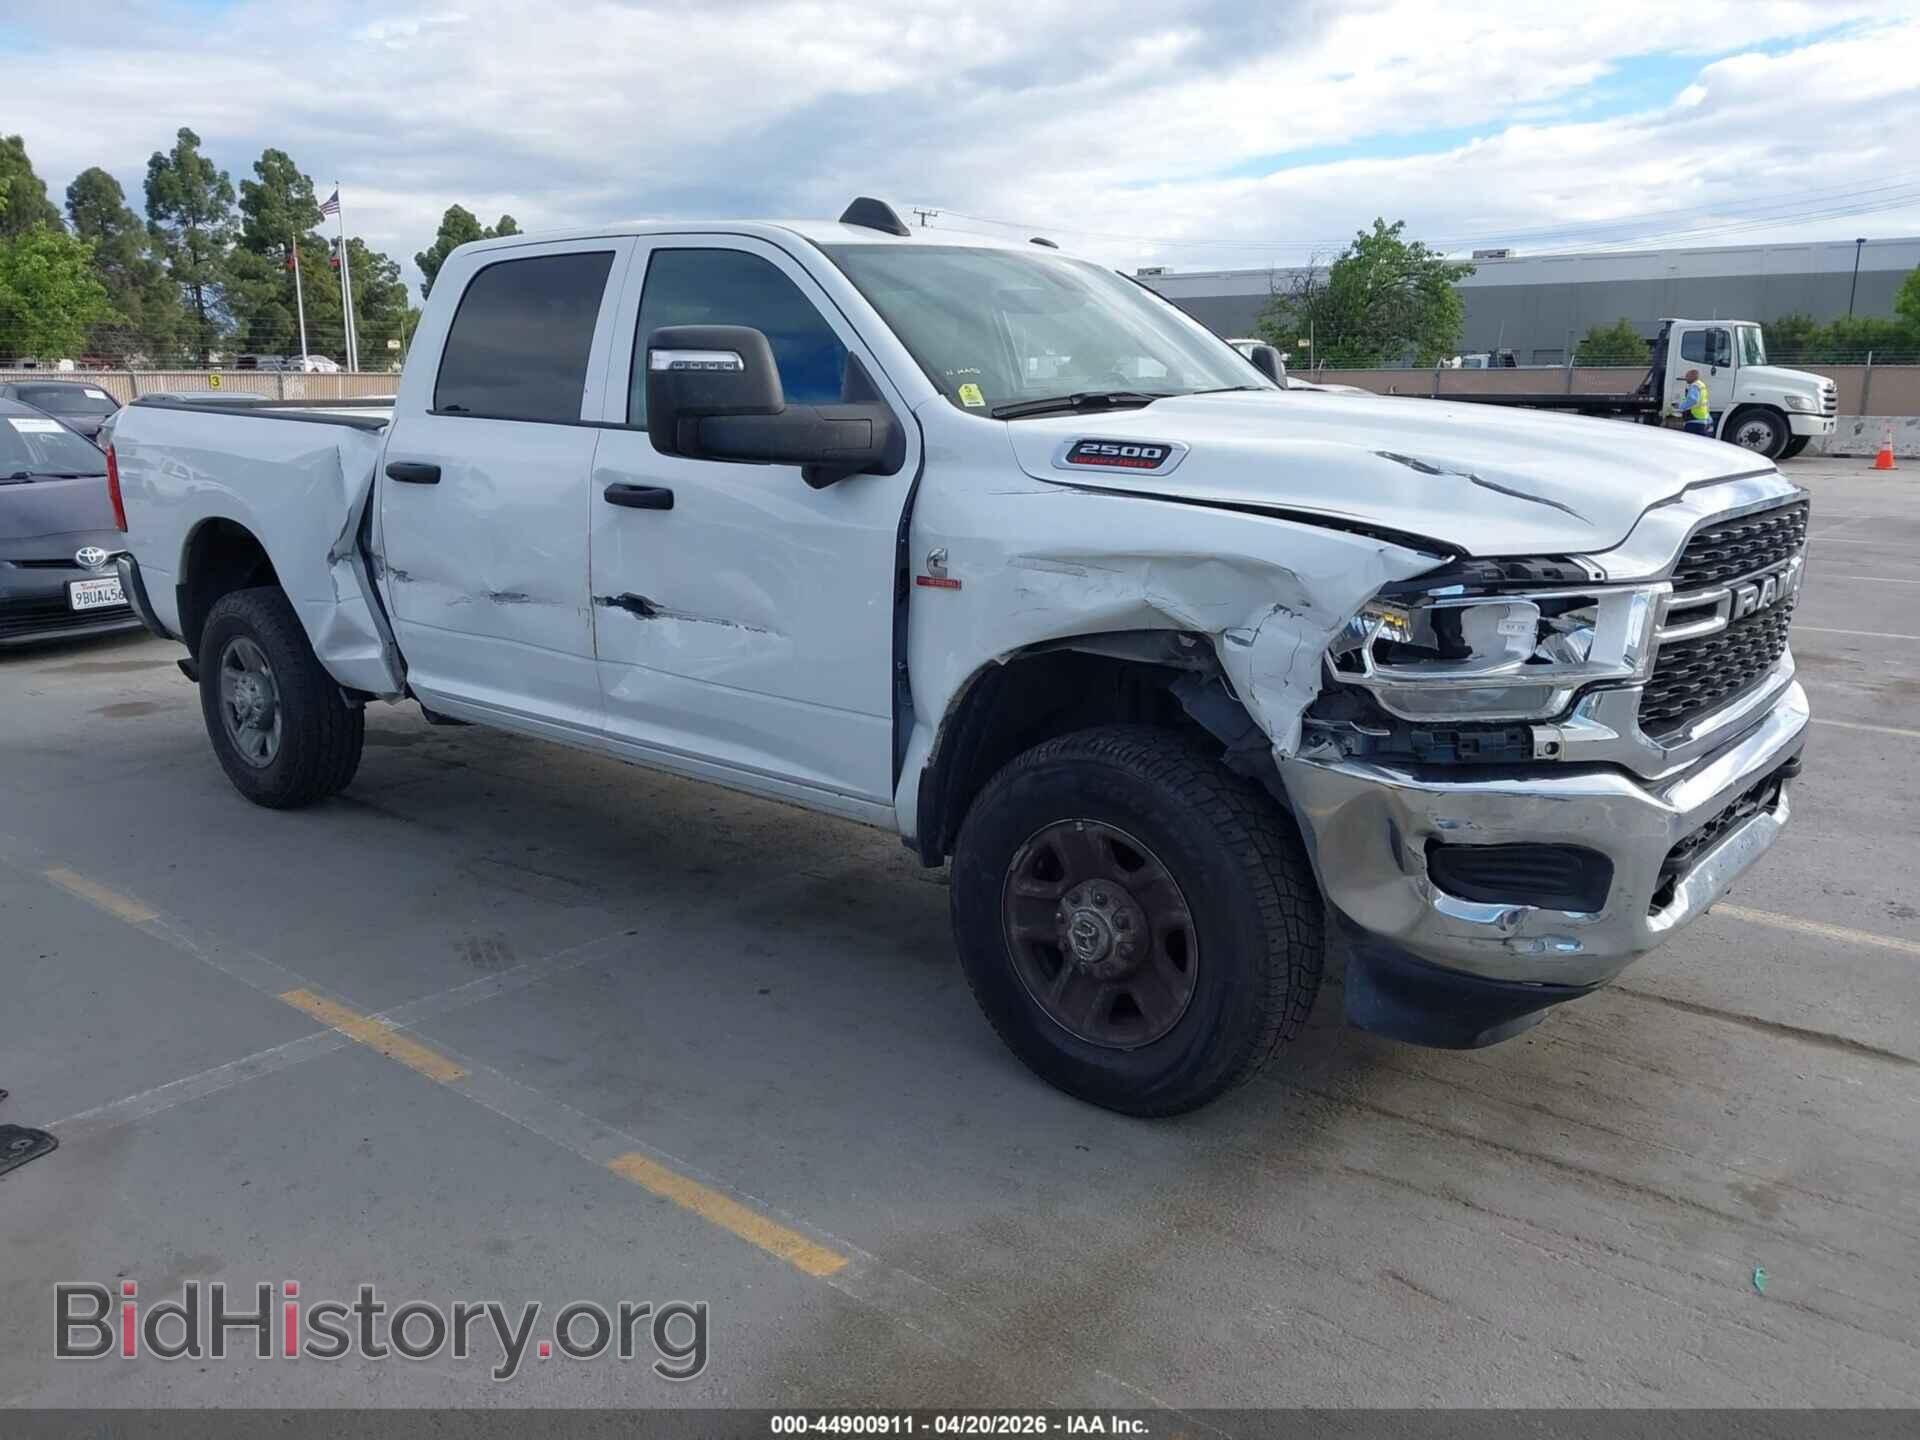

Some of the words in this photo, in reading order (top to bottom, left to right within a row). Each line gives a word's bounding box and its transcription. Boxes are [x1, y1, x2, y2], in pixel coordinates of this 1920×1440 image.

[211, 376, 220, 387] 3
[1079, 443, 1162, 459] 2500
[1731, 569, 1796, 619] RAM
